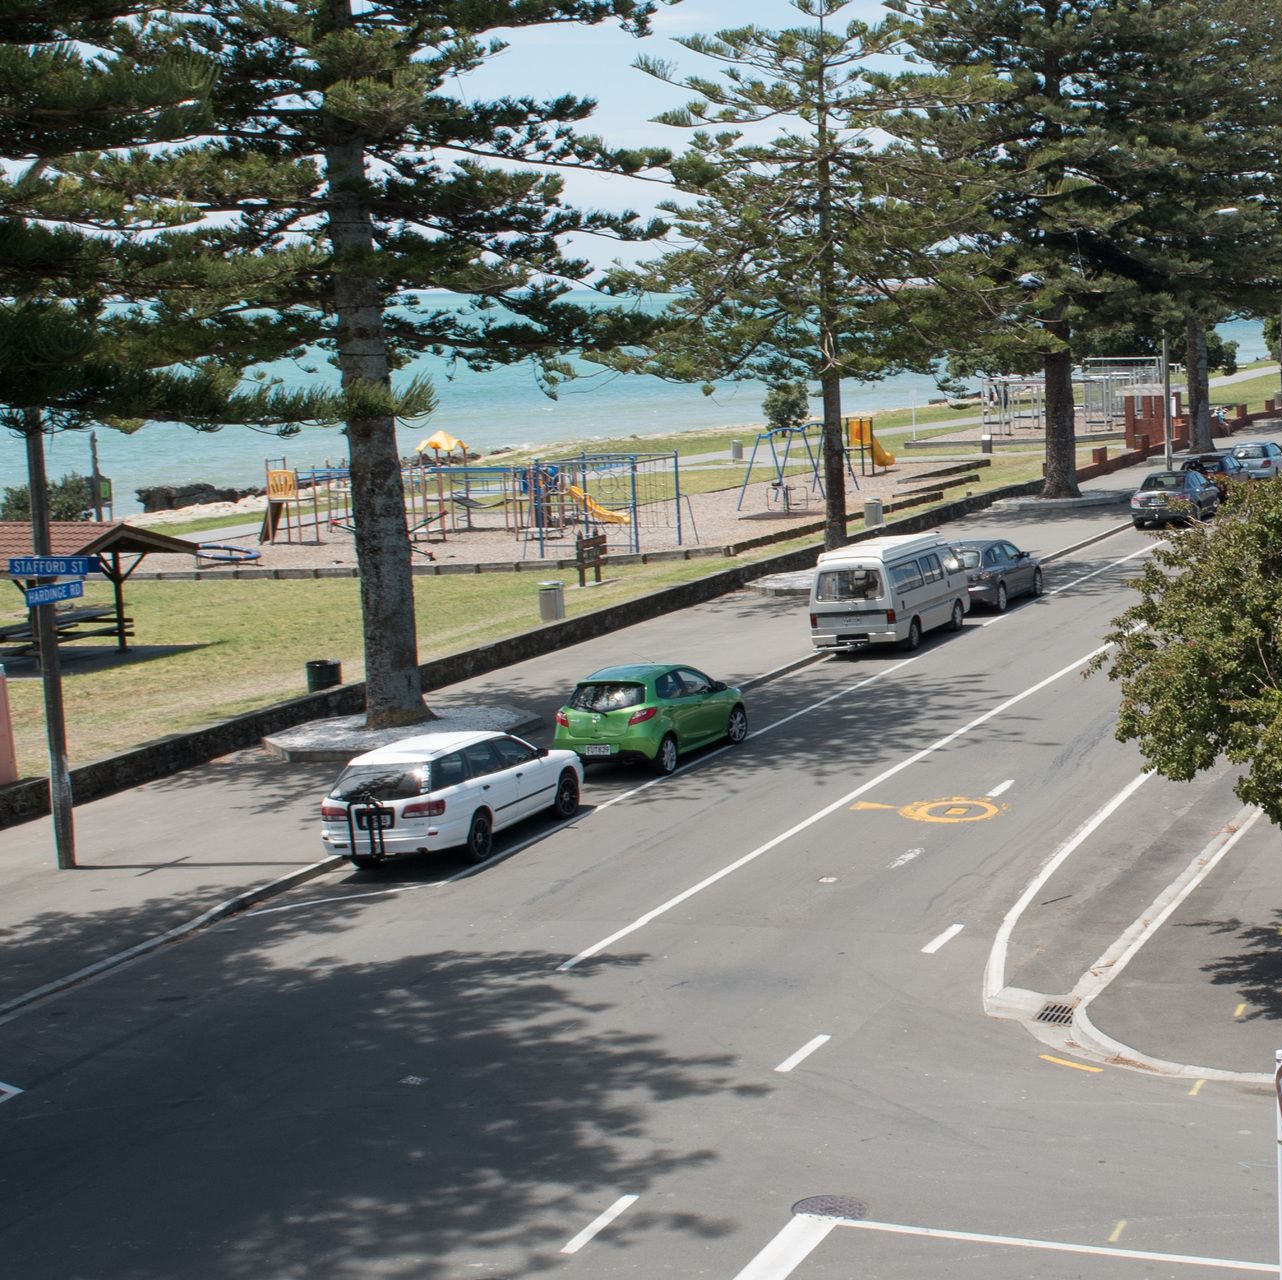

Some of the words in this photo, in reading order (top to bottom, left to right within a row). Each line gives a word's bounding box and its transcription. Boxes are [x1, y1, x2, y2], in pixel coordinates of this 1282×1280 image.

[14, 561, 66, 573] STAFFORD
[71, 561, 84, 573] ST
[28, 586, 67, 604] HARDINGE
[70, 583, 80, 597] RD
